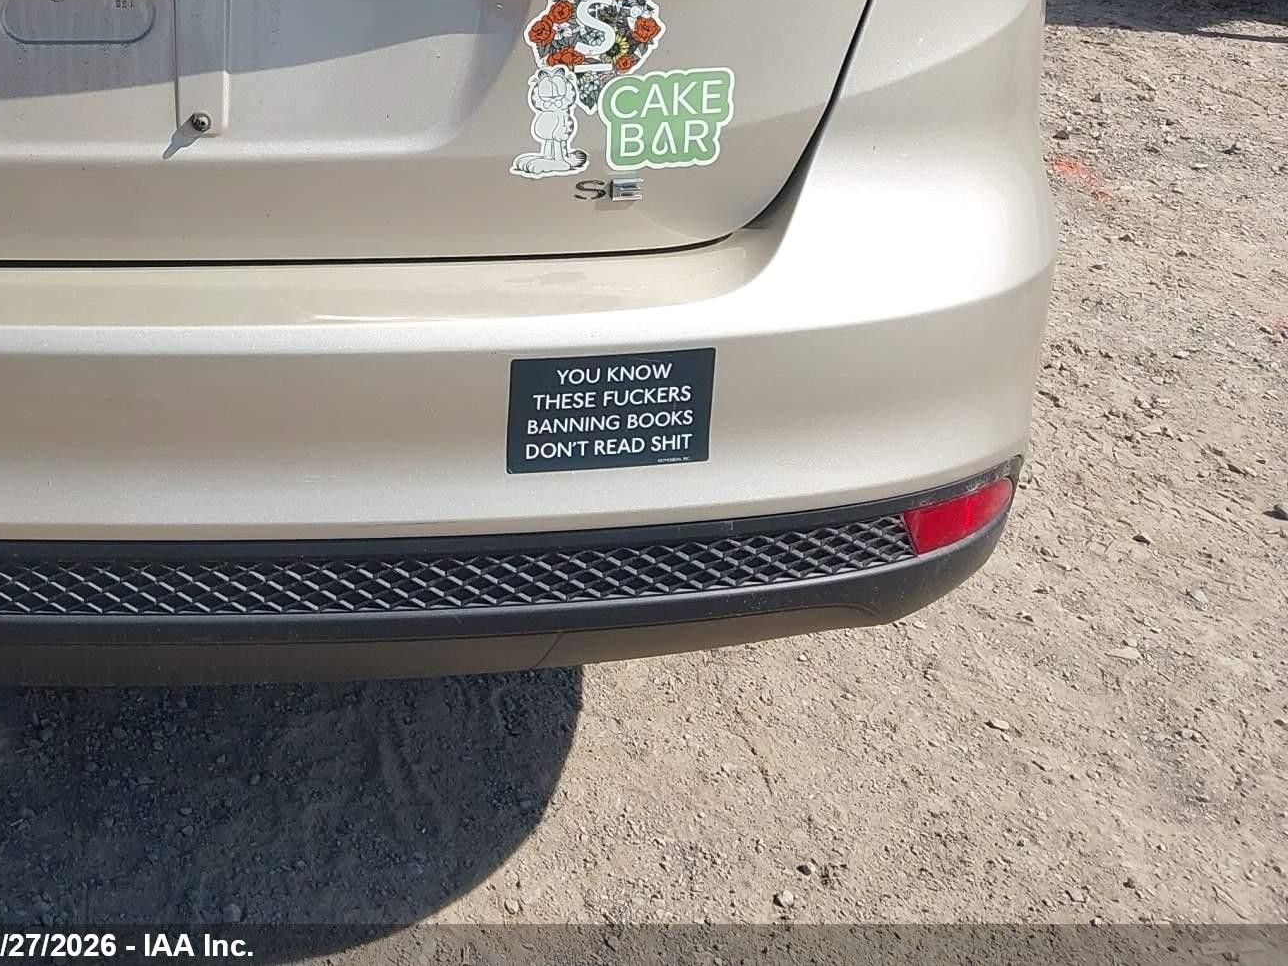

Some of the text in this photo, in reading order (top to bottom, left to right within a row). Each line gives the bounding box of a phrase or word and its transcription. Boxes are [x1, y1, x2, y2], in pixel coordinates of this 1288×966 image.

[610, 79, 724, 119] CAKE
[620, 119, 709, 158] BAR
[574, 178, 643, 201] SE
[556, 362, 673, 385] YOU KNOW
[533, 385, 692, 410] THESE FUCKERS
[527, 409, 694, 435] BANNING BOOKS
[525, 433, 693, 460] DON'T READ SHIT
